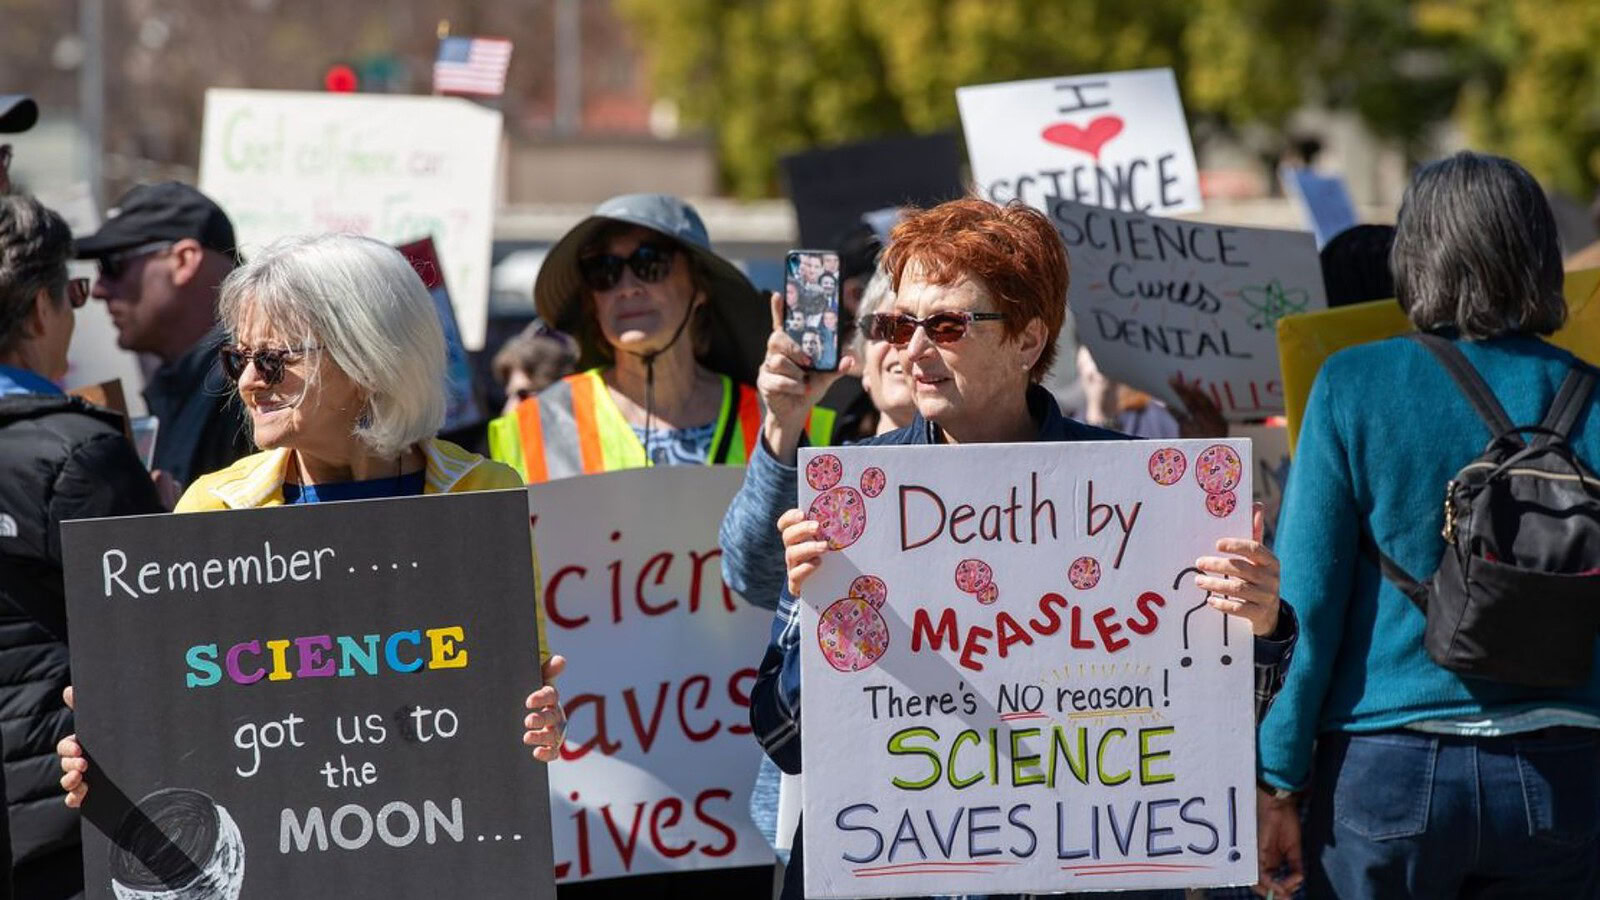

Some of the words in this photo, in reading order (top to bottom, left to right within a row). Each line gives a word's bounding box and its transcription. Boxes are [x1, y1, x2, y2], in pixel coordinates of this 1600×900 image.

[1055, 81, 1113, 113] I
[1054, 202, 1250, 267] SCIENCE
[1108, 263, 1222, 314] Cures
[1092, 309, 1254, 360] DENIAL
[899, 472, 1058, 552] Death
[1087, 480, 1143, 569] by
[185, 626, 469, 689] SCIENCE
[911, 591, 1166, 672] MEASLES
[558, 667, 759, 762] aves
[863, 681, 977, 720] There's
[997, 683, 1044, 713] NO
[233, 712, 305, 778] got
[336, 714, 387, 744] us
[409, 705, 459, 743] to
[320, 755, 378, 788] the
[886, 725, 1176, 791] SCIENCE
[554, 787, 737, 879] ives
[835, 803, 1038, 863] SAVES
[1056, 786, 1242, 863] LIVES!
